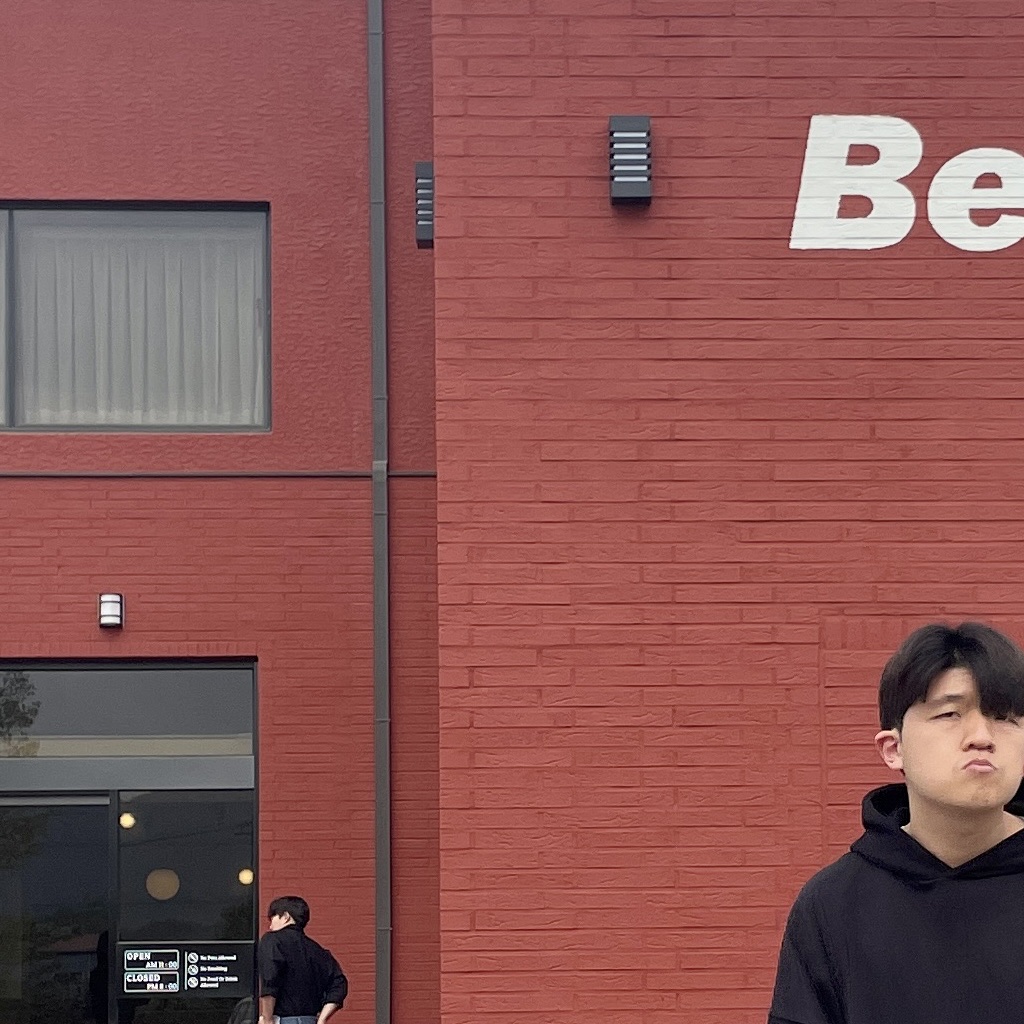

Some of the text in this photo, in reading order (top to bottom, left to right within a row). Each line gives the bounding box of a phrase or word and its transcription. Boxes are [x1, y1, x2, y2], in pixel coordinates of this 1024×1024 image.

[127, 953, 150, 961] OPEN
[146, 961, 157, 969] AM
[127, 974, 160, 982] CLOSED
